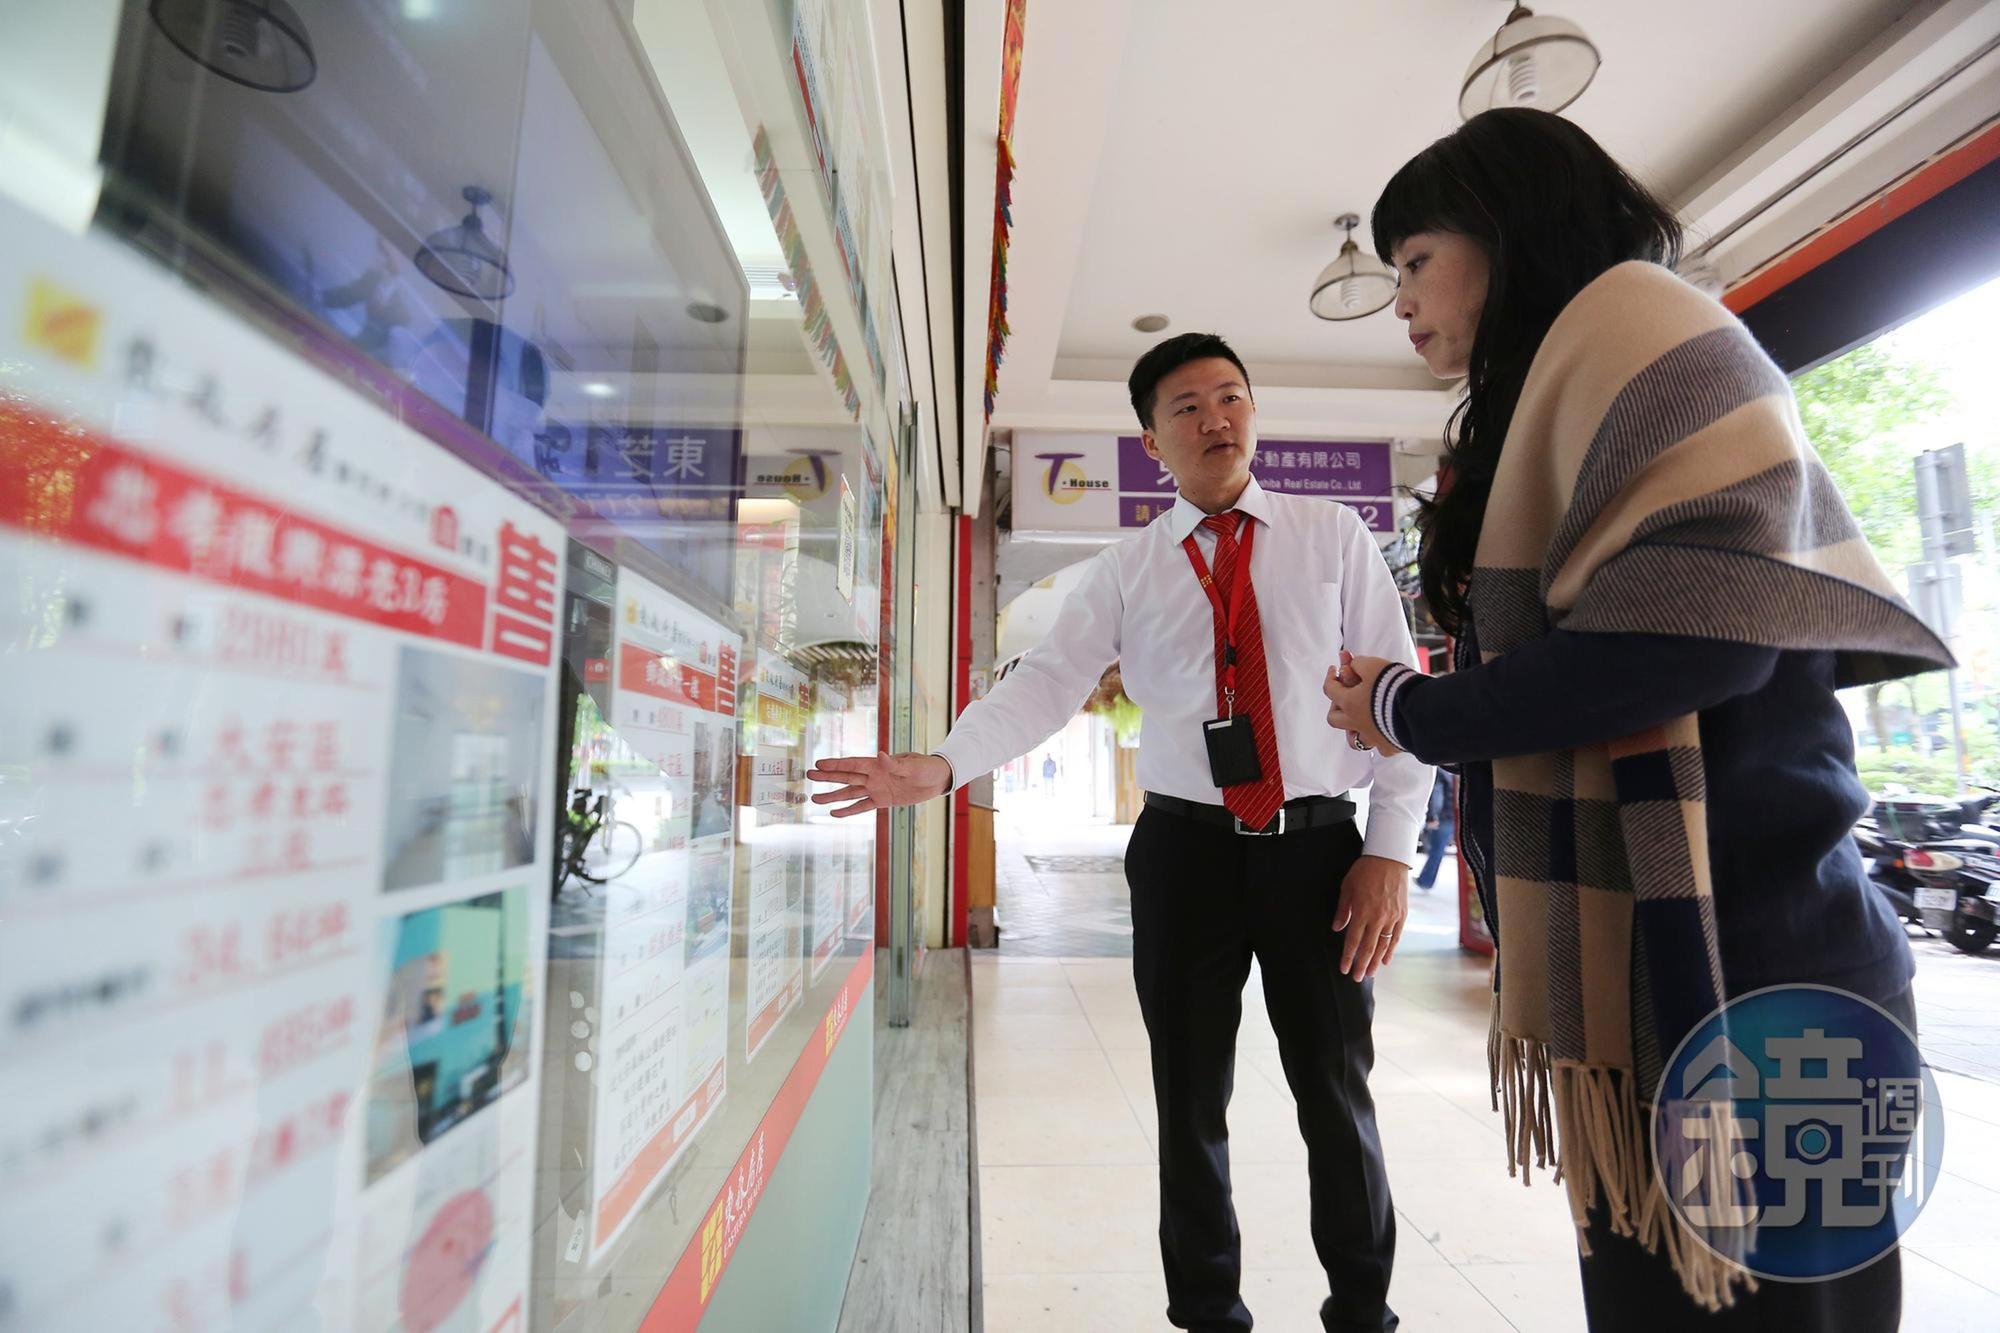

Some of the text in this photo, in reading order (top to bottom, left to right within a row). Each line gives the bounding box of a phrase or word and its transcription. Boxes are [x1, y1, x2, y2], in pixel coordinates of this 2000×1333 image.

[1252, 451, 1361, 469] 不動產有限公司
[1070, 478, 1109, 488] House
[1284, 478, 1302, 489] Real
